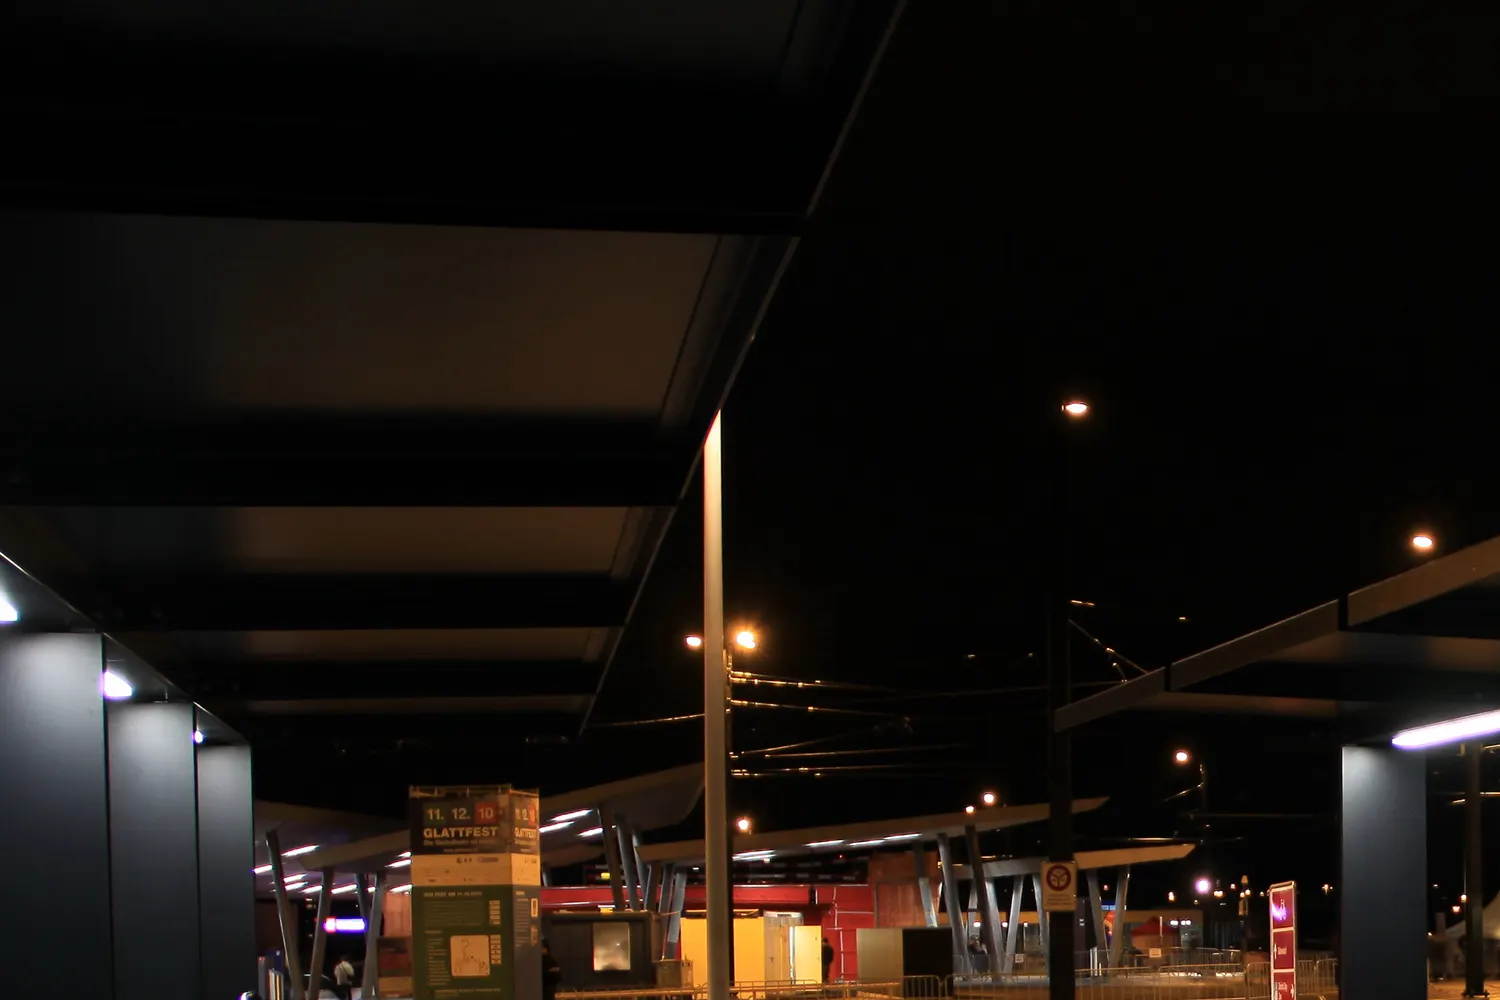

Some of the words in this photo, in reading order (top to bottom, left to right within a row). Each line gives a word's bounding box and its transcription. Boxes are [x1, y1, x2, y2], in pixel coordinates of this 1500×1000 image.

[426, 808, 444, 821] 11.
[451, 807, 471, 820] 12.
[478, 807, 494, 820] 10
[423, 826, 499, 839] GLATTFEST
